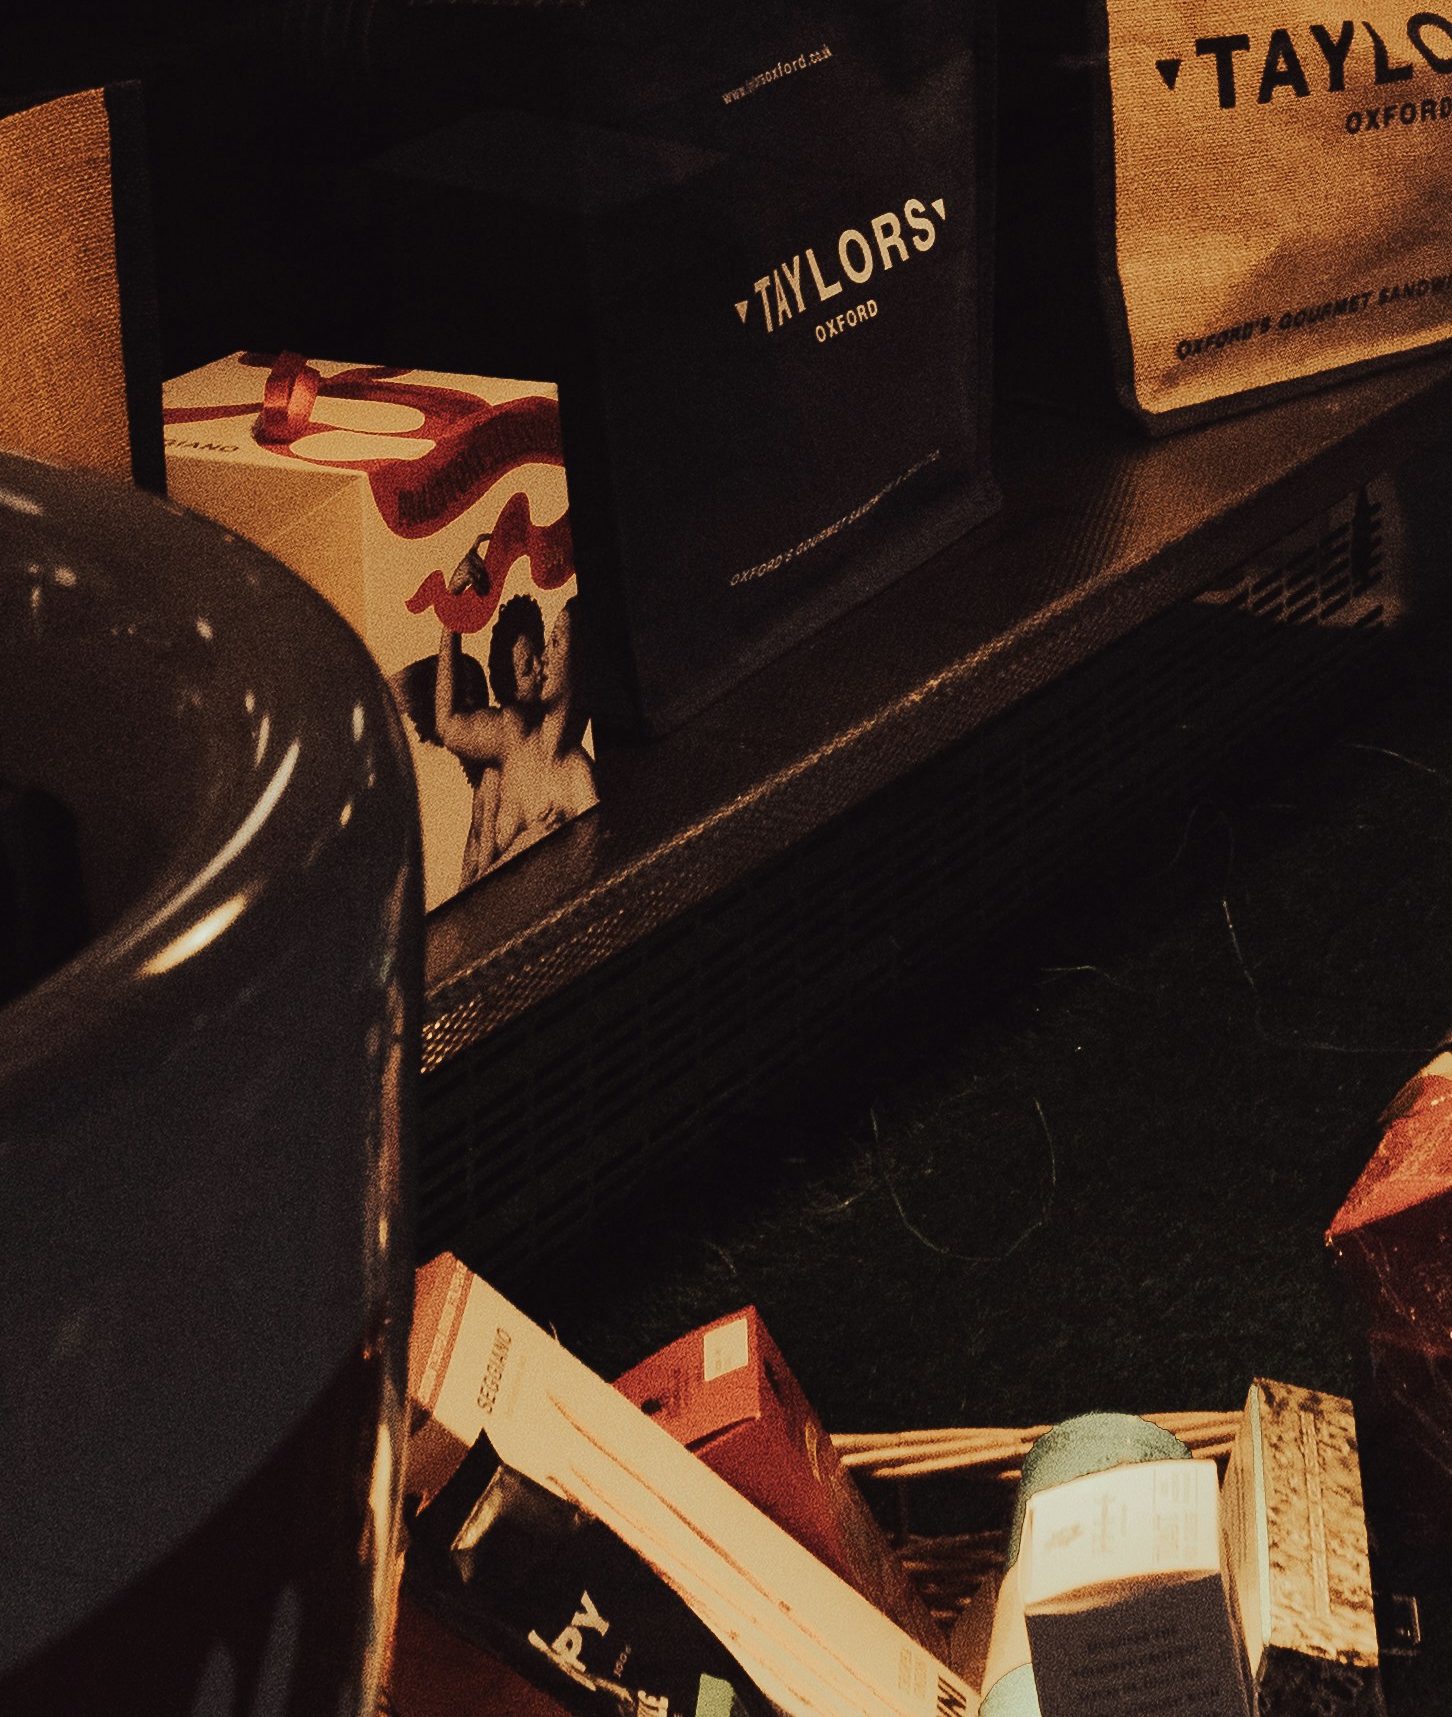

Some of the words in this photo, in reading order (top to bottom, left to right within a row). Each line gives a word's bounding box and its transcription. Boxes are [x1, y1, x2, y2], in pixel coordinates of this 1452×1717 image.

[1346, 95, 1452, 135] OXFORD
[751, 197, 938, 335] TAYLORS
[812, 297, 881, 345] OXFORD
[1177, 318, 1270, 358] OXFORD'S
[1278, 291, 1372, 331] GOURMET
